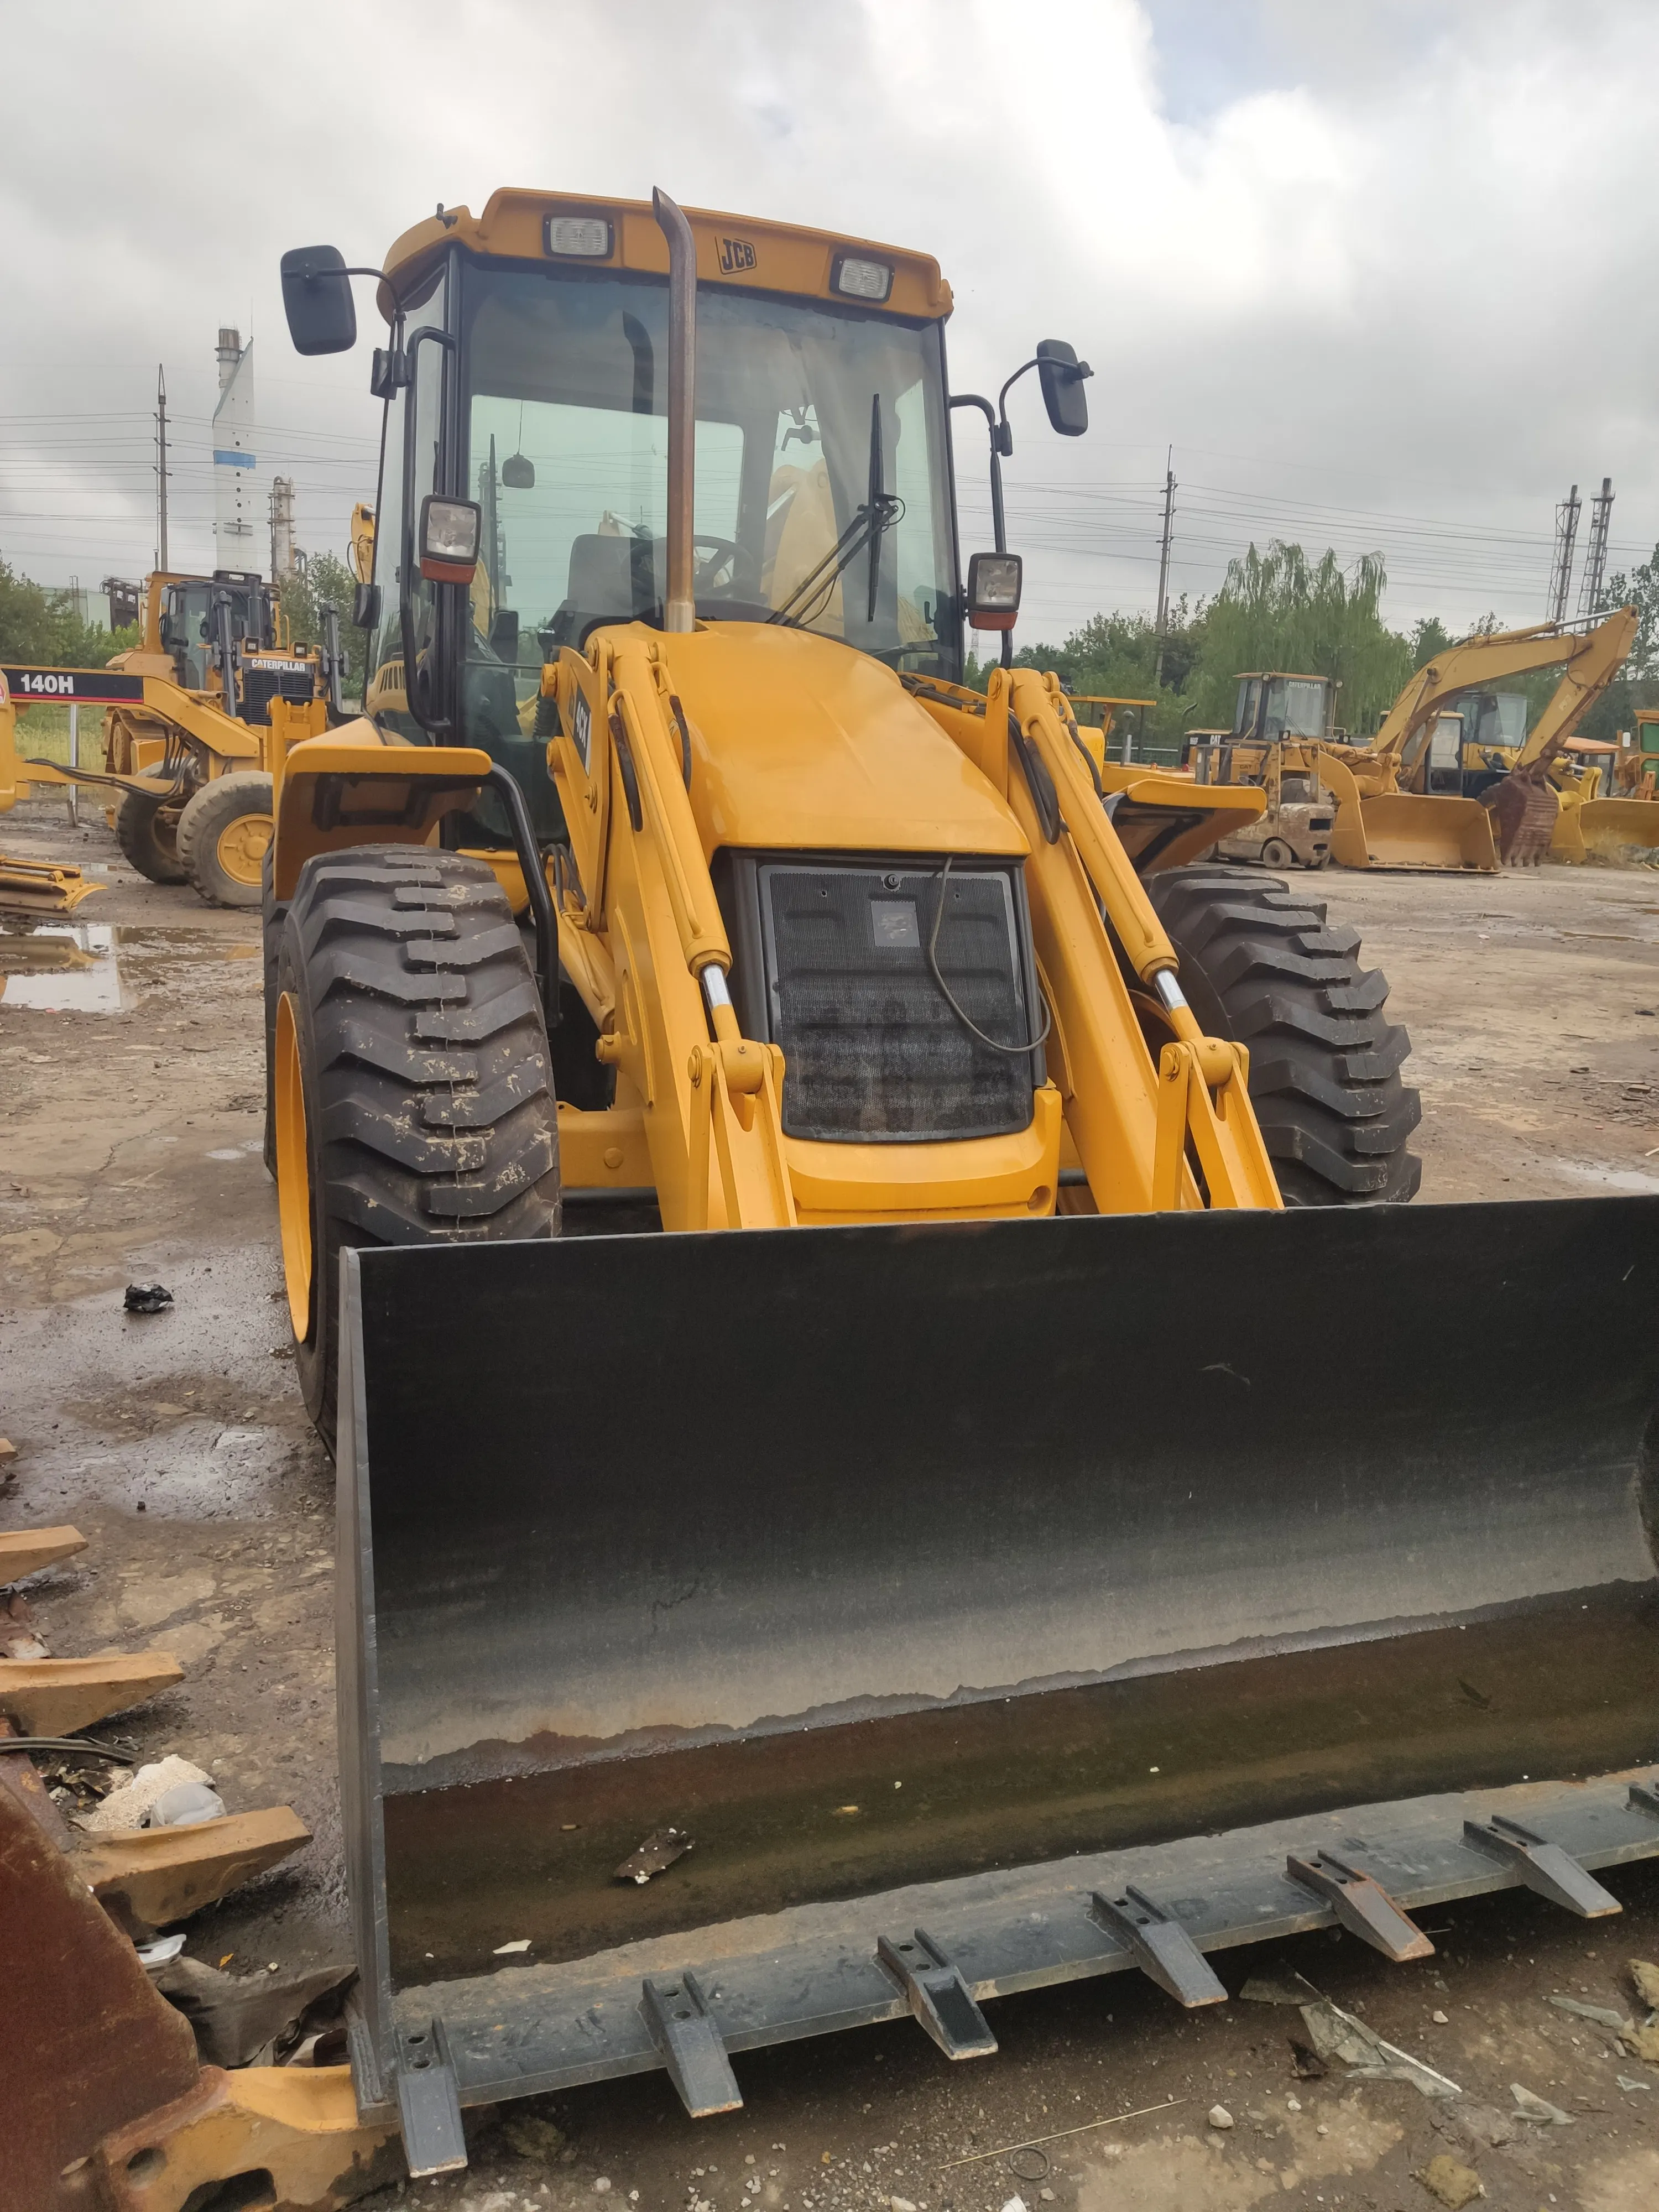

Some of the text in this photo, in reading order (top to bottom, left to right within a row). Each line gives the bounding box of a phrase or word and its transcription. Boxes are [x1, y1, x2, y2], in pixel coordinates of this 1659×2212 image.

[722, 238, 754, 270] JCB
[252, 659, 305, 671] CATERPILLAR
[21, 674, 74, 694] 140H
[576, 701, 588, 749] 4CX
[1210, 735, 1221, 745] CAT
